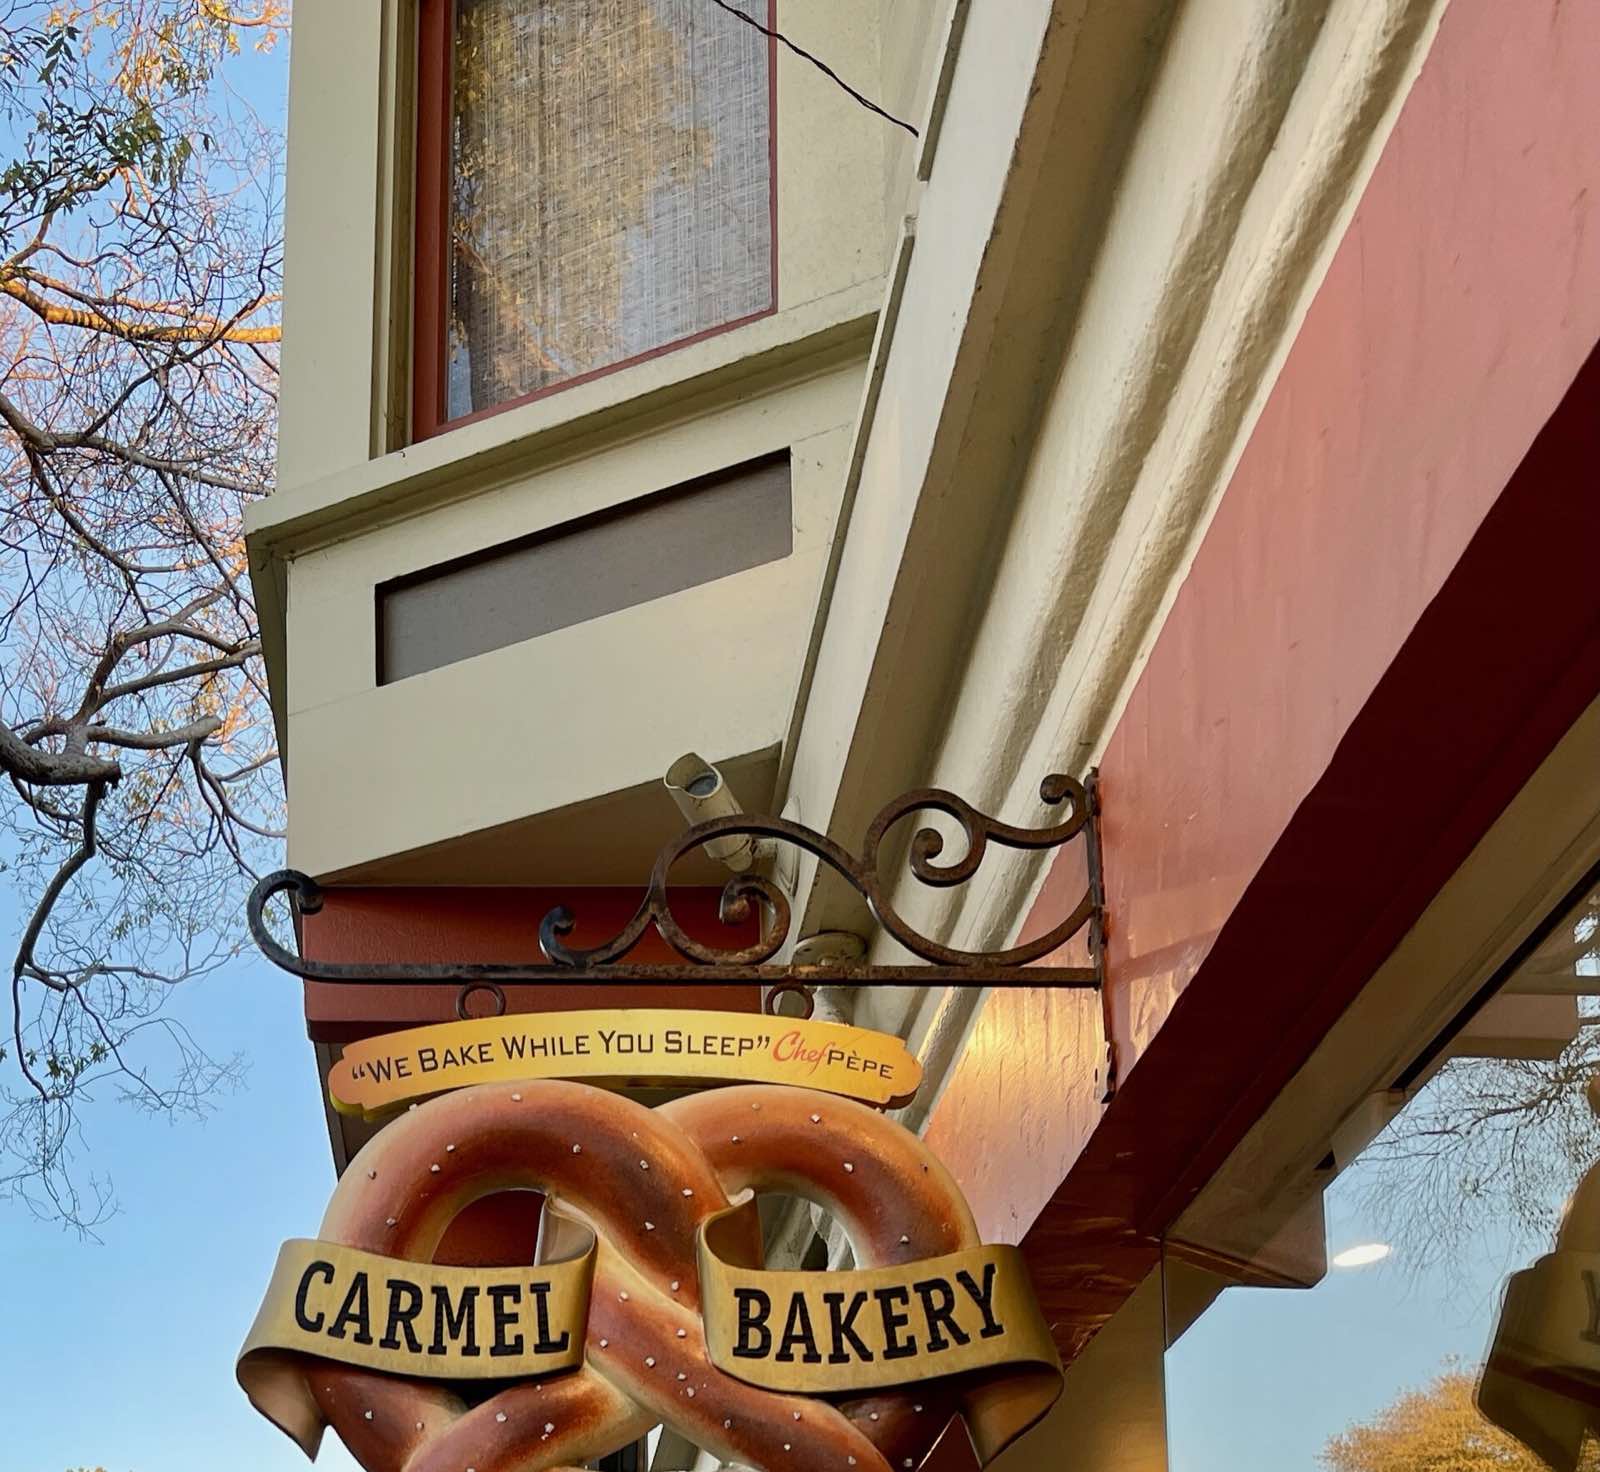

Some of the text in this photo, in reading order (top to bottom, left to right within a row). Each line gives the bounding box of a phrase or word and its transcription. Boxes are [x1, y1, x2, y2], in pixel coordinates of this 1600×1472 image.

[417, 1042, 494, 1073] BAKE
[501, 1034, 591, 1060] WHILE
[597, 1030, 653, 1054] YOU
[772, 1030, 834, 1076] Chef
[294, 1259, 1005, 1365] CARMEL BAKERY
